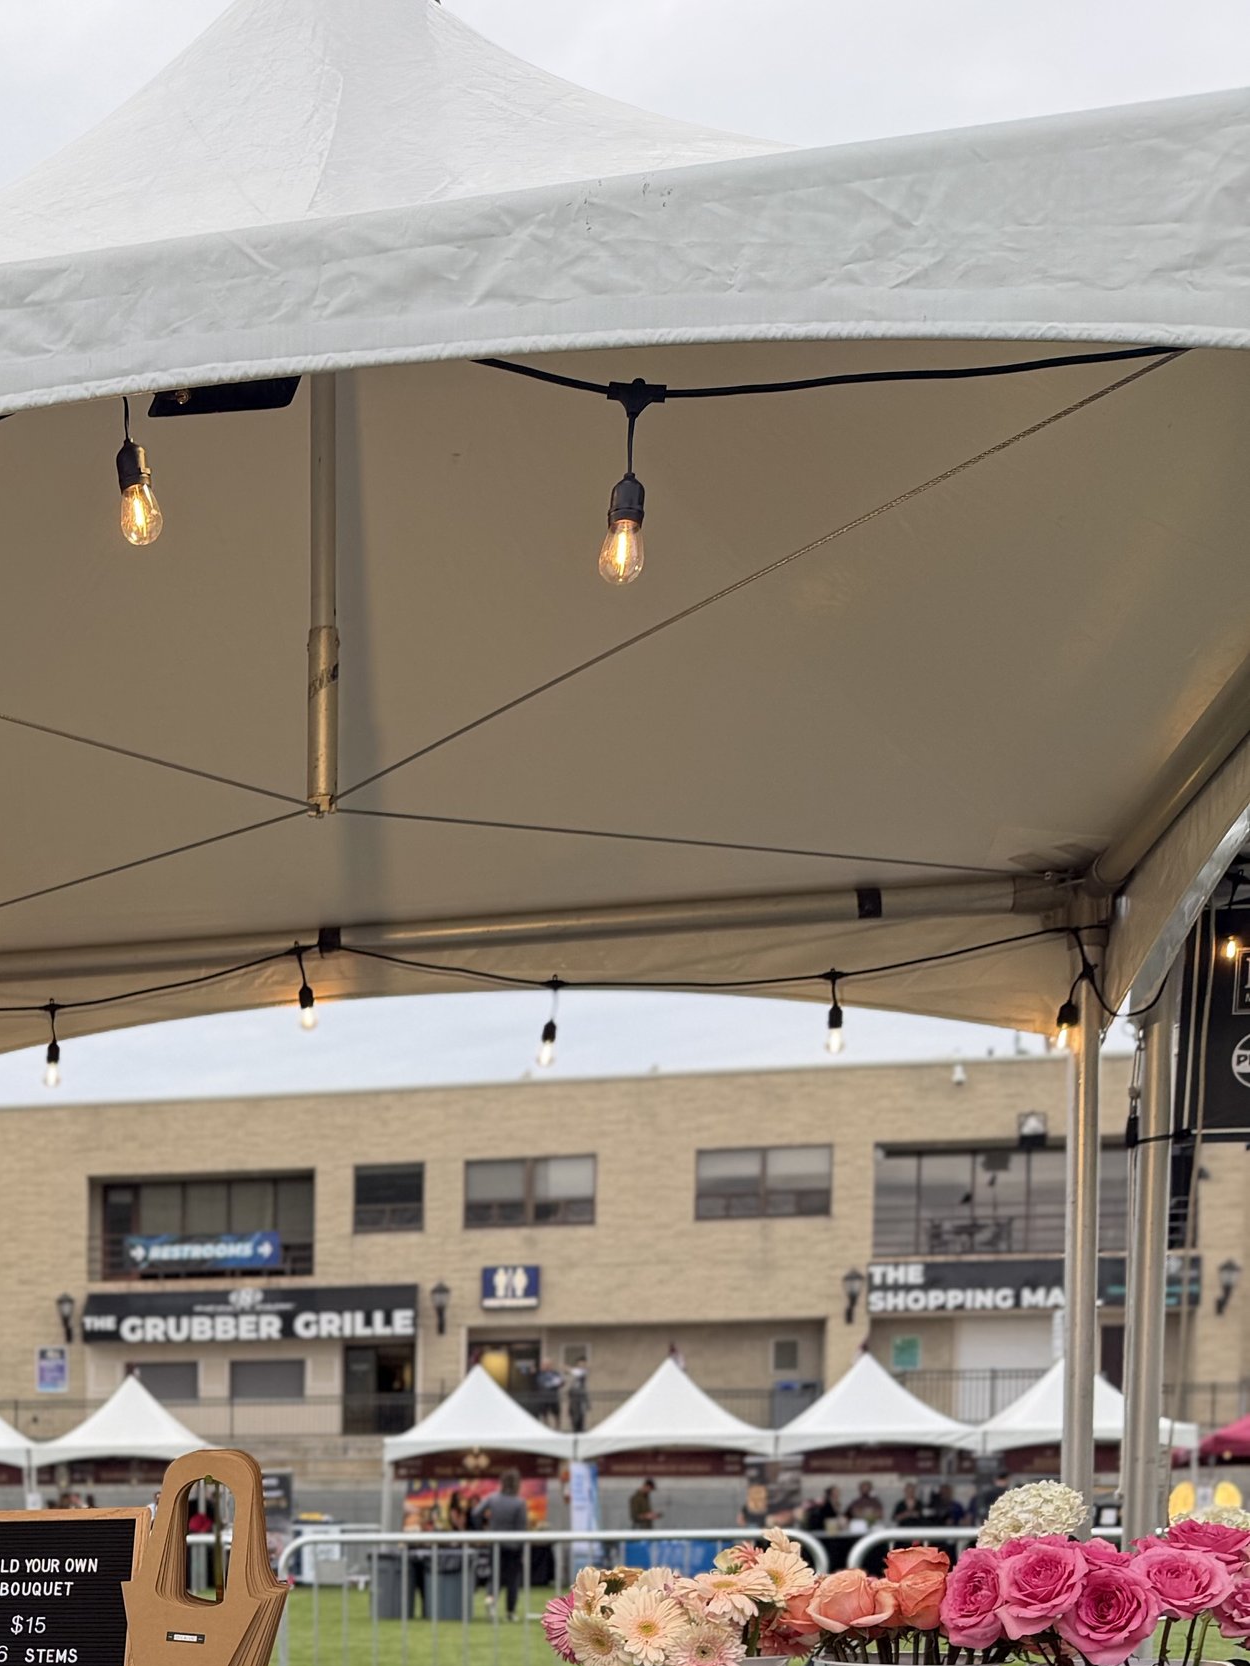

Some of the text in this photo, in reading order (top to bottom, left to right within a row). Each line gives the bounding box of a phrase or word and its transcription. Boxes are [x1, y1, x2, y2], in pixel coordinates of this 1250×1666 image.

[149, 1242, 254, 1260] RESTROOMS
[868, 1264, 925, 1285] THE
[868, 1288, 1014, 1311] SHOPPING
[83, 1310, 415, 1342] THE GRUBBER GRILLE
[25, 1558, 60, 1573] YOUR
[64, 1557, 98, 1573] OWN
[0, 1581, 74, 1596] BOUQUET
[10, 1614, 46, 1635] $15
[24, 1648, 78, 1664] STEMS
